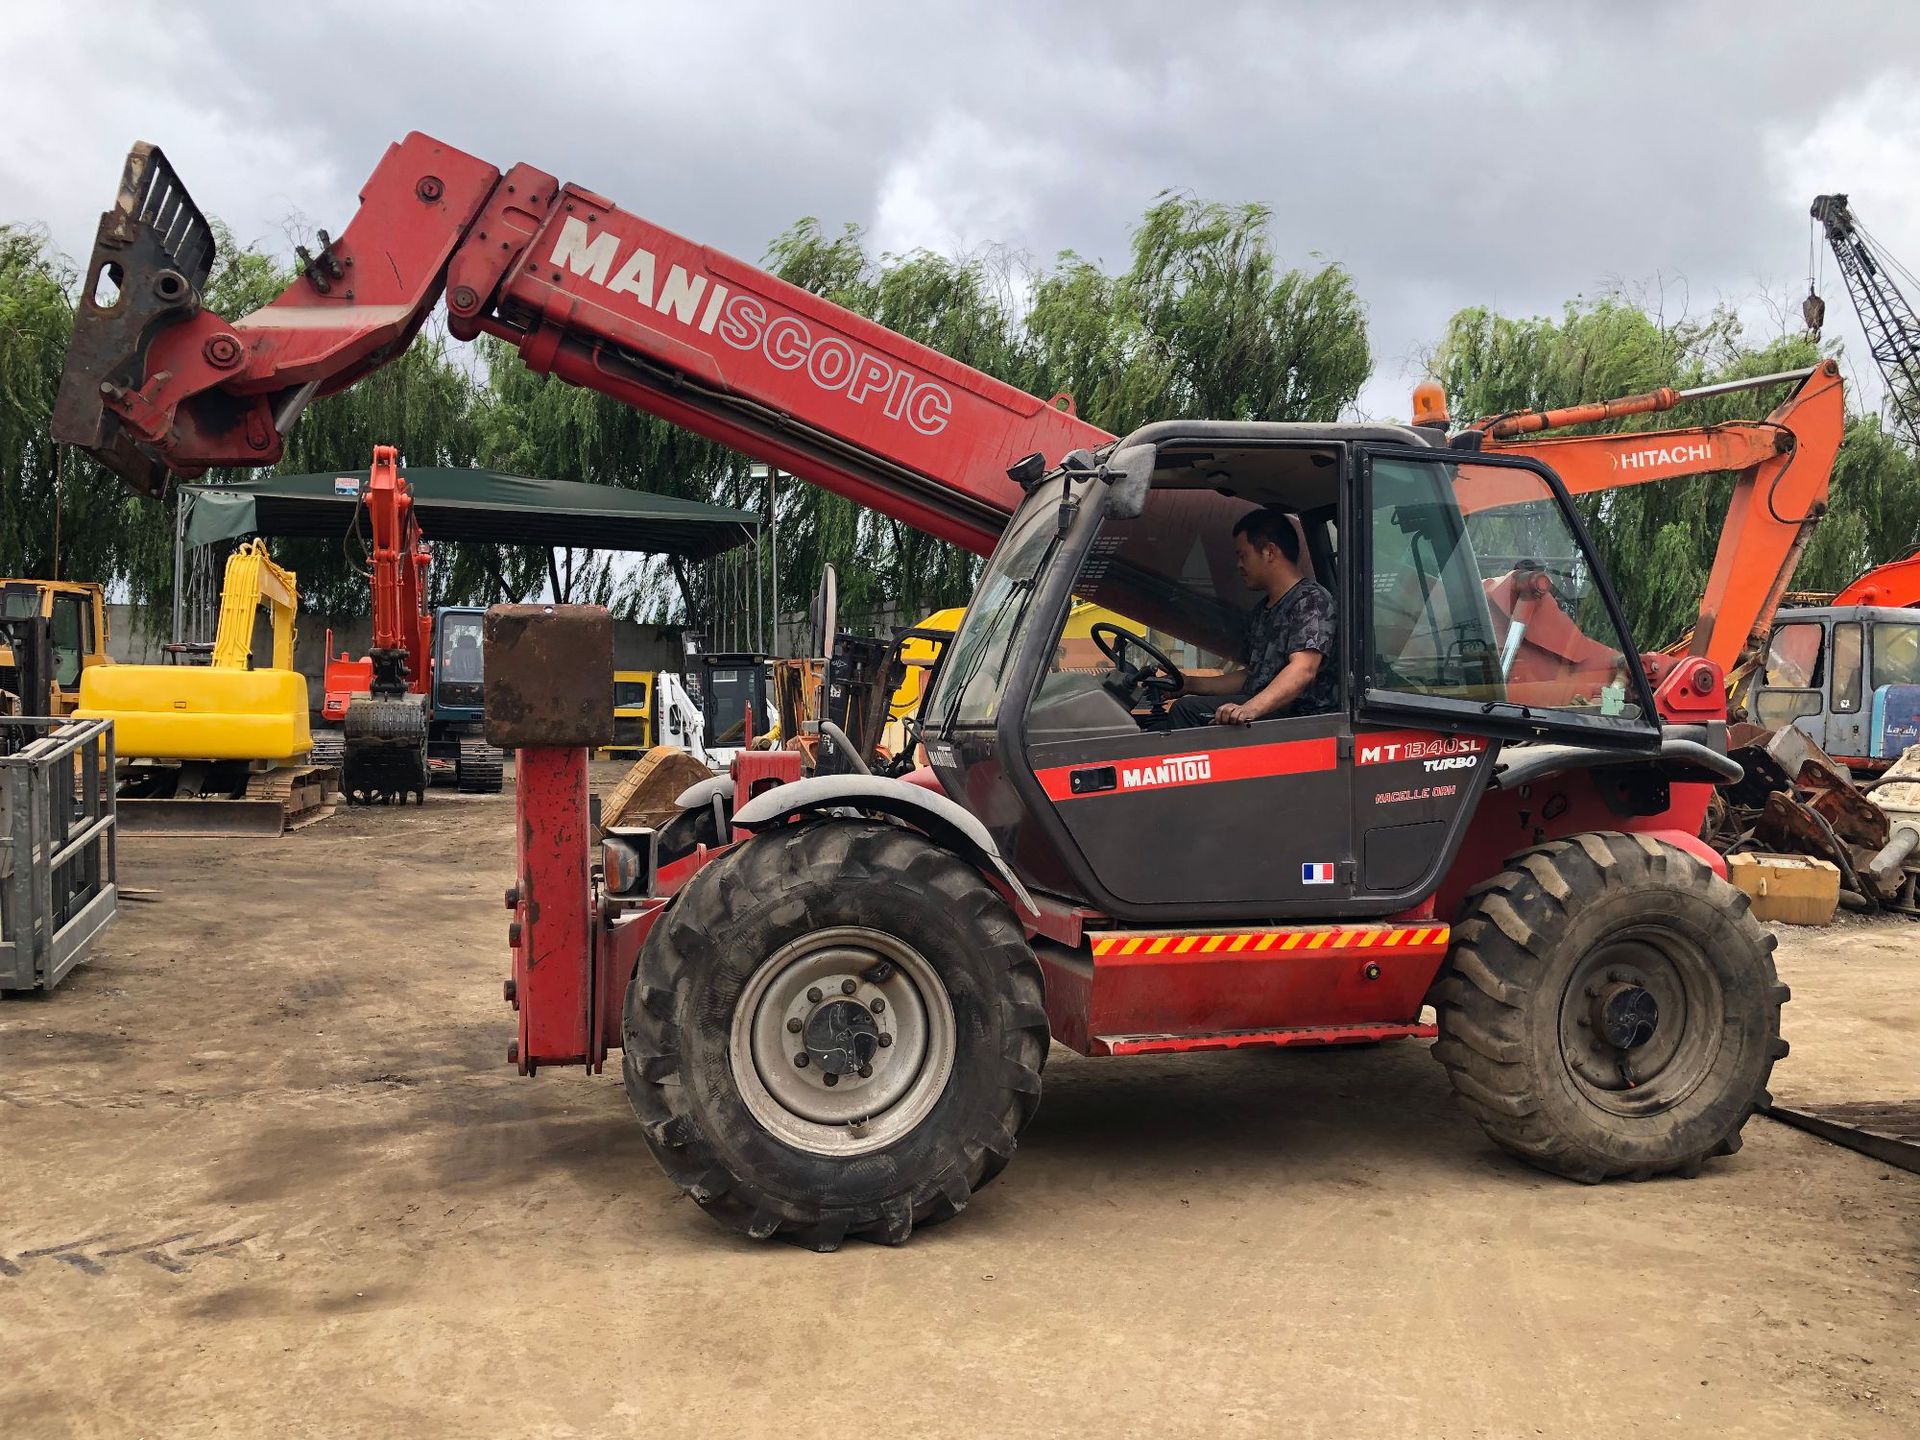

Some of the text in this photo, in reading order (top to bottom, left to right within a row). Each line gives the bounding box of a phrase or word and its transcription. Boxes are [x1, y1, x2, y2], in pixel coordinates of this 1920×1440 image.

[1838, 241, 1859, 275] HITACHI
[549, 215, 952, 436] MANISCOPIC
[1621, 443, 1712, 470] HITACHI
[1886, 724, 1918, 737] Lady
[1360, 743, 1401, 764] MT
[1423, 755, 1478, 773] TURBO
[1122, 754, 1212, 788] MANITOU
[1375, 787, 1430, 804] NACELLE
